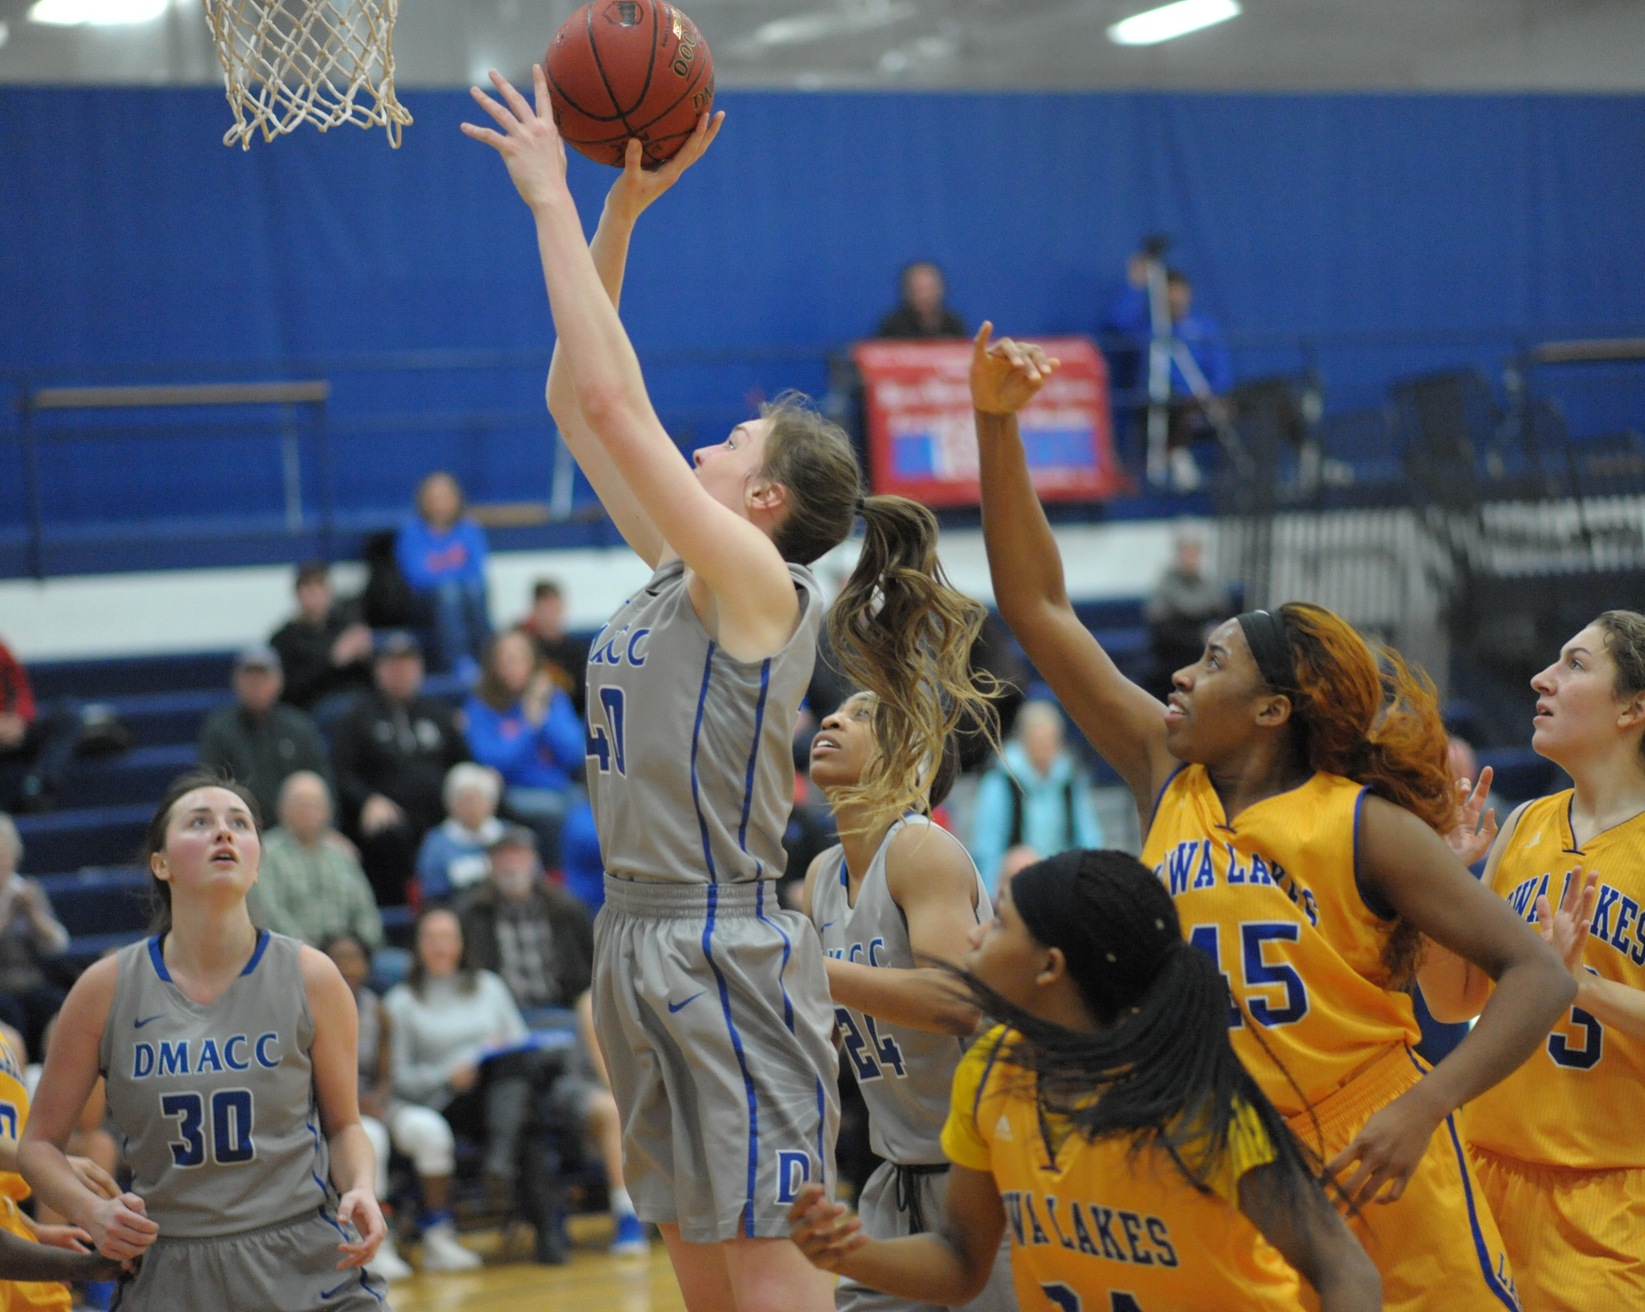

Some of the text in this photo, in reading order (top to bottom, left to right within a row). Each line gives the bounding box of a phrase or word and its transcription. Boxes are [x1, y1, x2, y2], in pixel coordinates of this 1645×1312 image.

[131, 1031, 283, 1080] DMACC
[833, 1004, 909, 1083] 24
[159, 1086, 257, 1169] 30
[773, 1149, 812, 1206] D
[1045, 1195, 1180, 1269] LAKES
